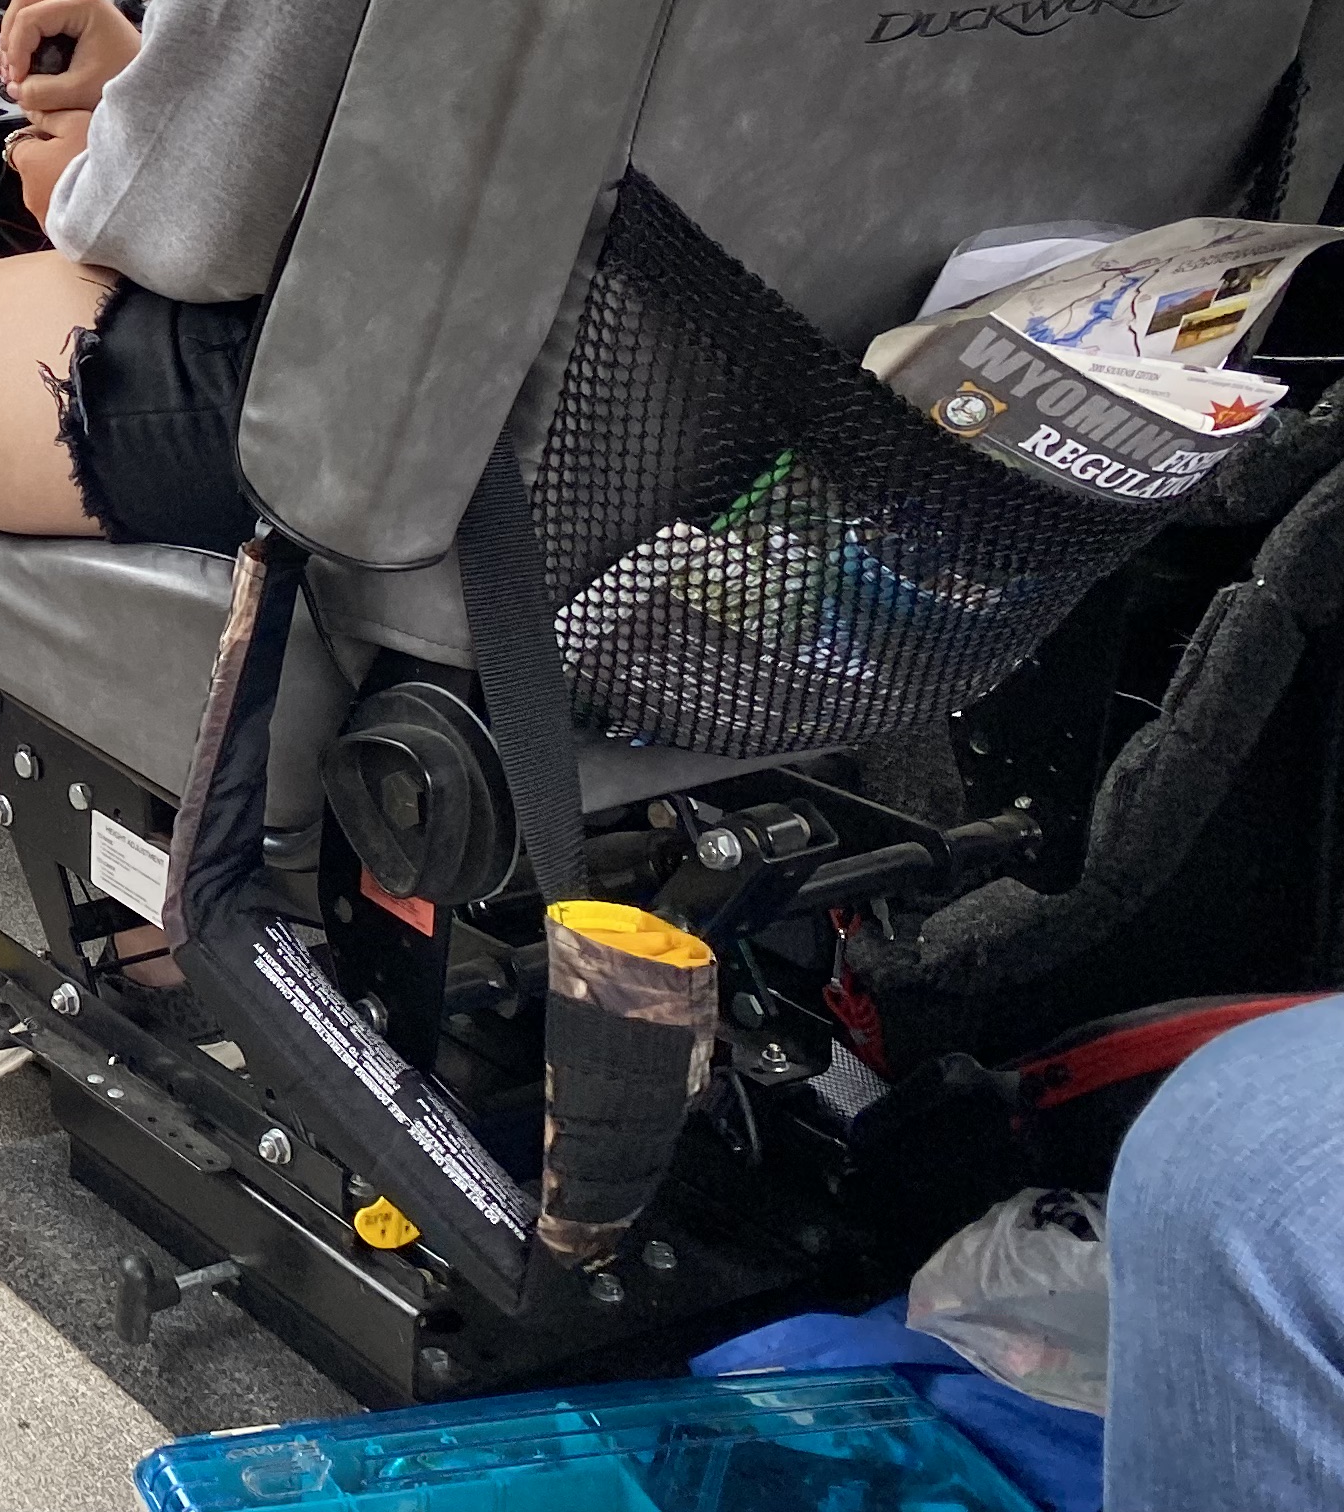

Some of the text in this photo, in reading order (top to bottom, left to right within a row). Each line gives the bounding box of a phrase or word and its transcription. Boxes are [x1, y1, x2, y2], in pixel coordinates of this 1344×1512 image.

[289, 996, 306, 1014] ON
[300, 1009, 357, 1069] INSTRUCTIONS
[352, 1065, 391, 1107] DONNING
[386, 1102, 407, 1124] SEE
[405, 1124, 433, 1153] BACK
[428, 1149, 446, 1167] ON
[441, 1163, 469, 1193] WEAR
[465, 1189, 487, 1212] NOT
[482, 1207, 500, 1225] DO
[489, 1200, 527, 1242] WARNING
